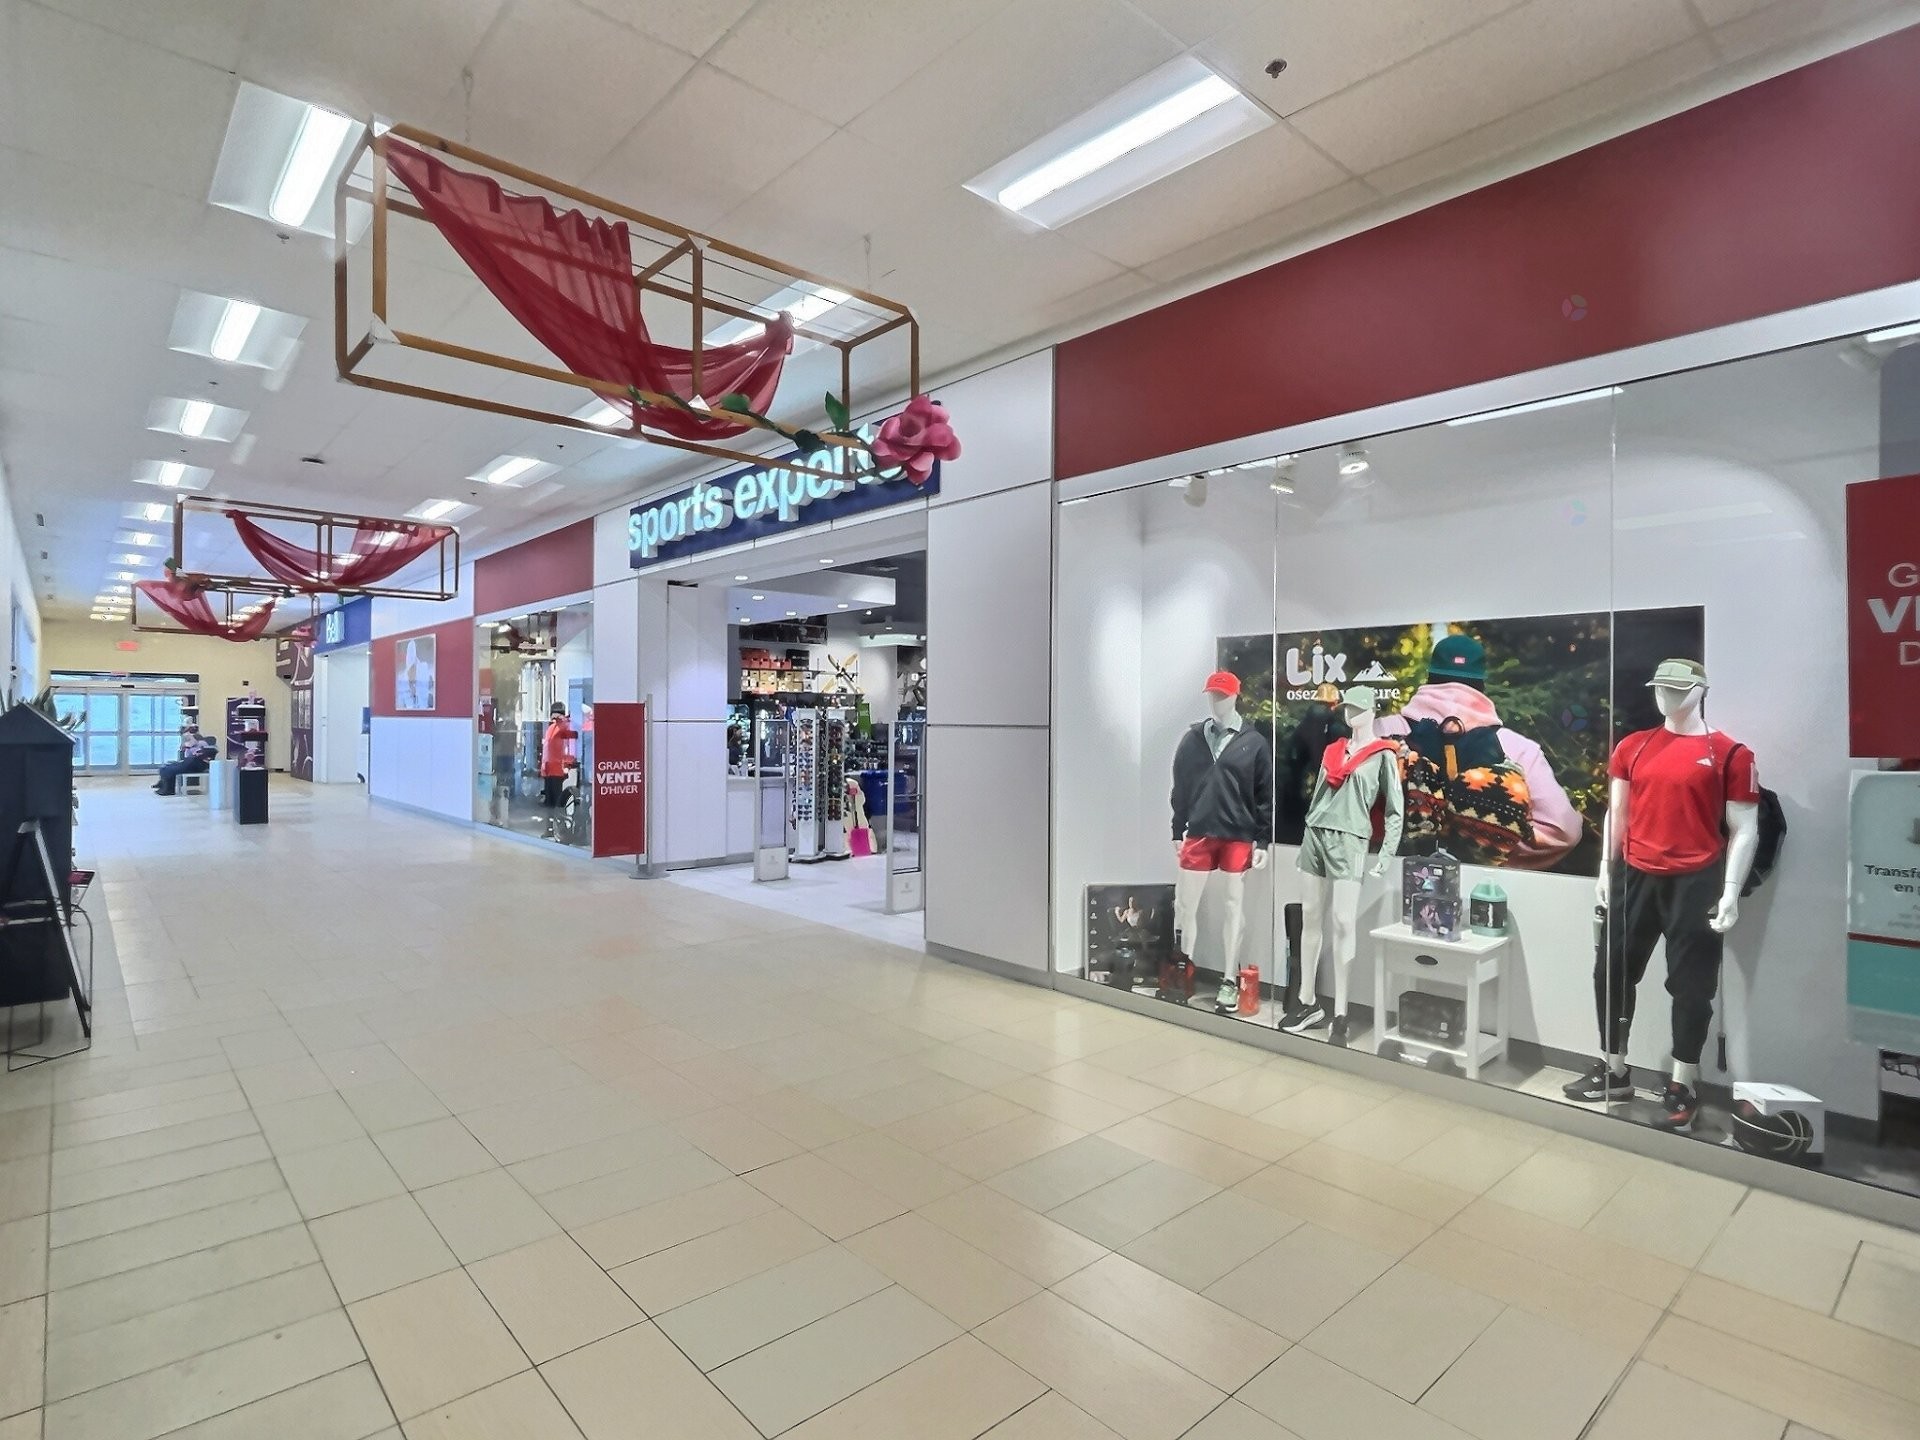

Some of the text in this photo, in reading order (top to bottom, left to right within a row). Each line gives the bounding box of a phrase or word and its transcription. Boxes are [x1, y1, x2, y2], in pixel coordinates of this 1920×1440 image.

[628, 482, 724, 558] sports
[1866, 595, 1920, 634] V
[1286, 645, 1347, 686] Lix
[1286, 689, 1319, 700] osez
[598, 760, 640, 771] GRANDE
[596, 771, 642, 784] VENTE
[600, 784, 639, 796] D'HIVER
[1894, 883, 1914, 893] en
